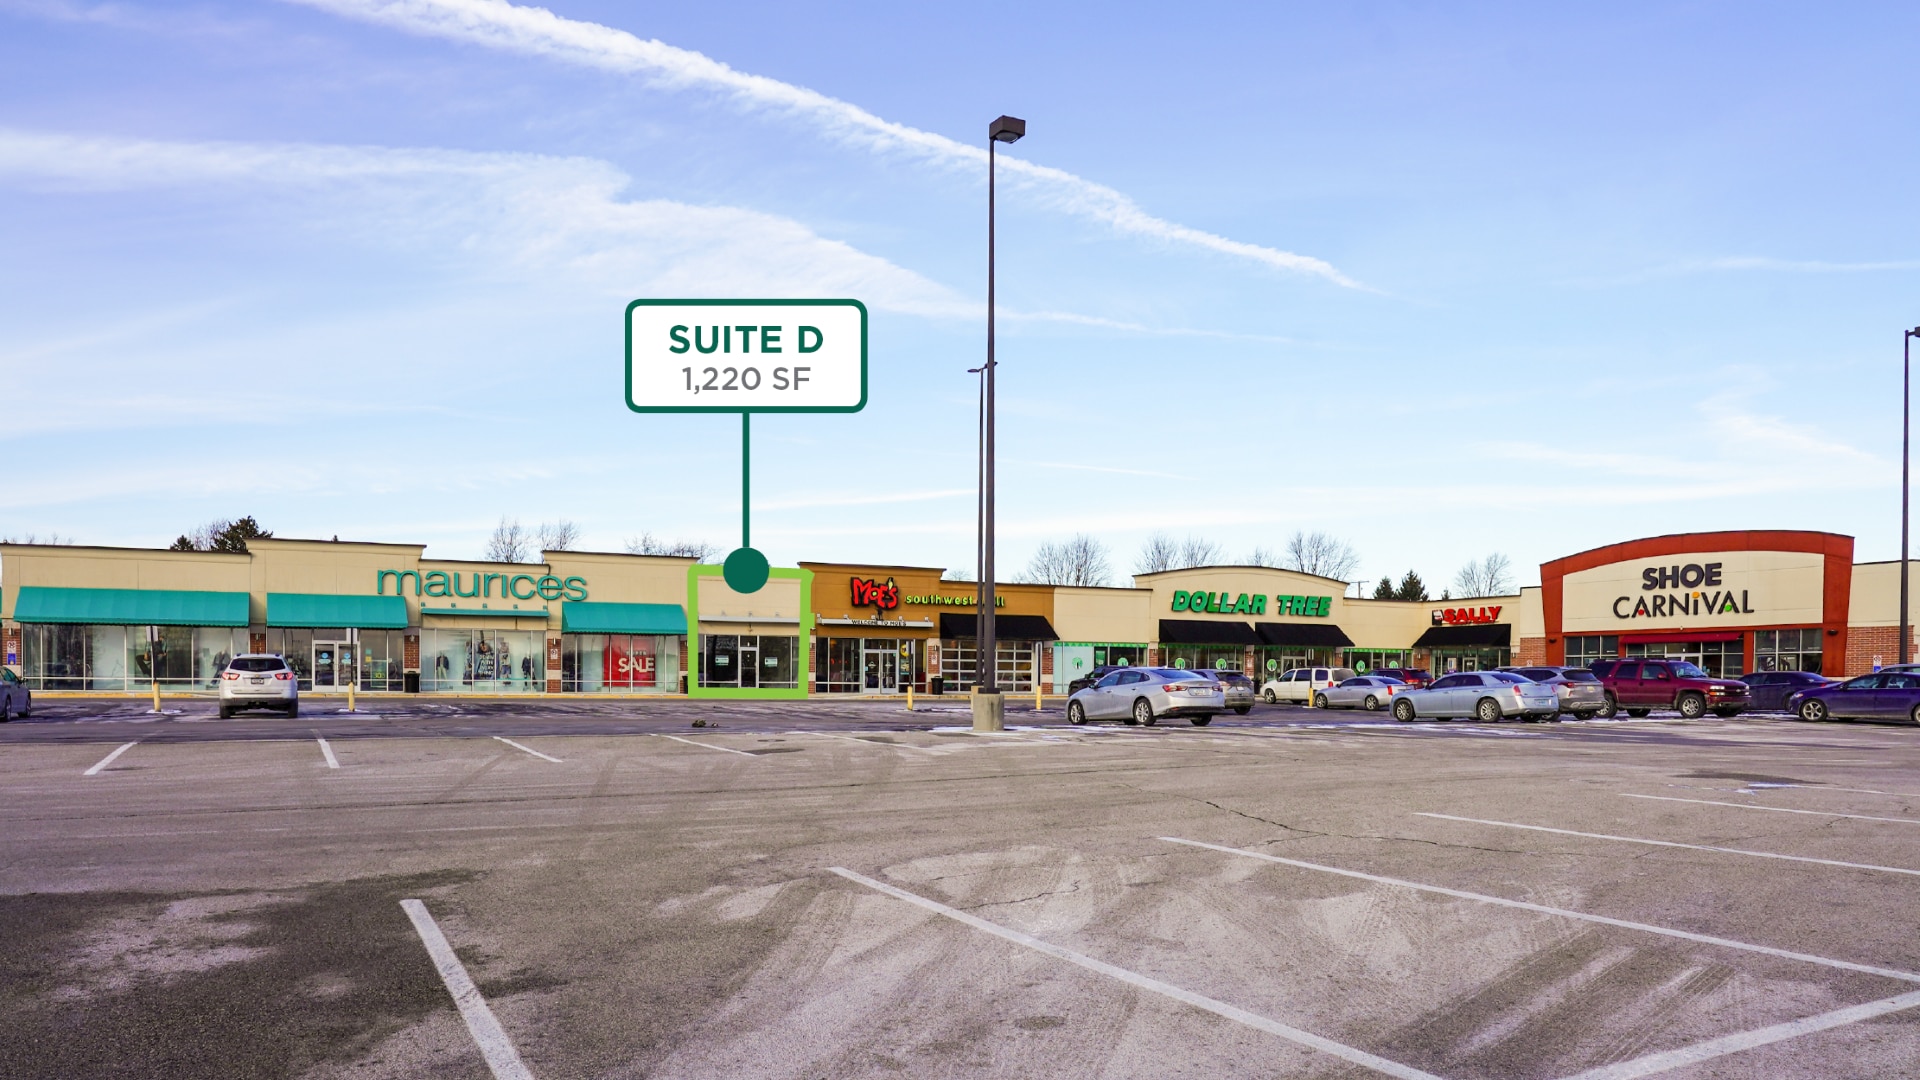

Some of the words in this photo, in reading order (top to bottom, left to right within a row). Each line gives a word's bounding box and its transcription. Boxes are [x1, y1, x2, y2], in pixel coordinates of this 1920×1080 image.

[377, 569, 588, 601] maurices
[1642, 562, 1722, 590] SHOE
[906, 595, 973, 606] southwest
[1172, 590, 1267, 615] DOLLAR
[1277, 595, 1332, 617] TREE
[1612, 590, 1755, 619] CARNIVAL
[1443, 606, 1502, 623] SALLY
[618, 657, 655, 673] SALE
